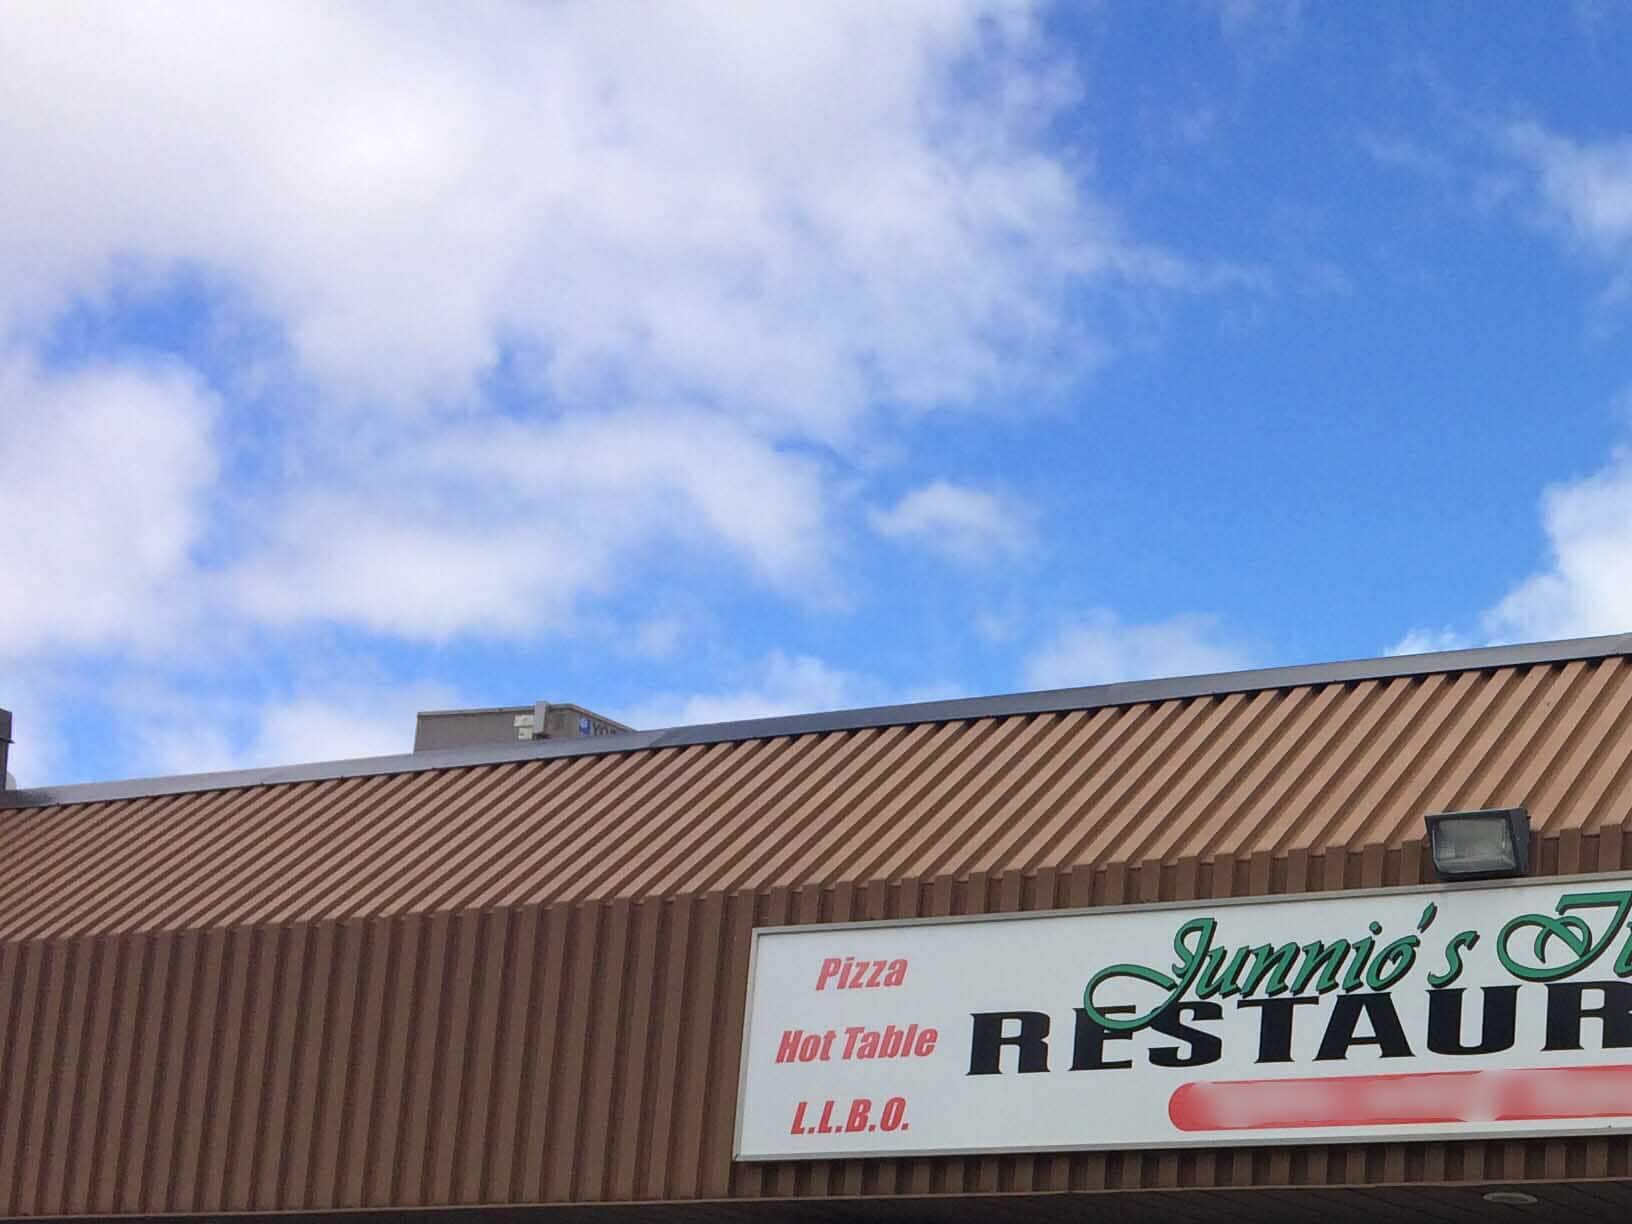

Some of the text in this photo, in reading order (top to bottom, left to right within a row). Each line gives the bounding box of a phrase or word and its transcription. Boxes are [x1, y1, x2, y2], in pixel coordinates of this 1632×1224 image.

[816, 957, 908, 992] Pizza
[1084, 902, 1480, 1031] Junnio's
[775, 1023, 938, 1064] Hot Table
[791, 1096, 910, 1136] L.L.B.O.
